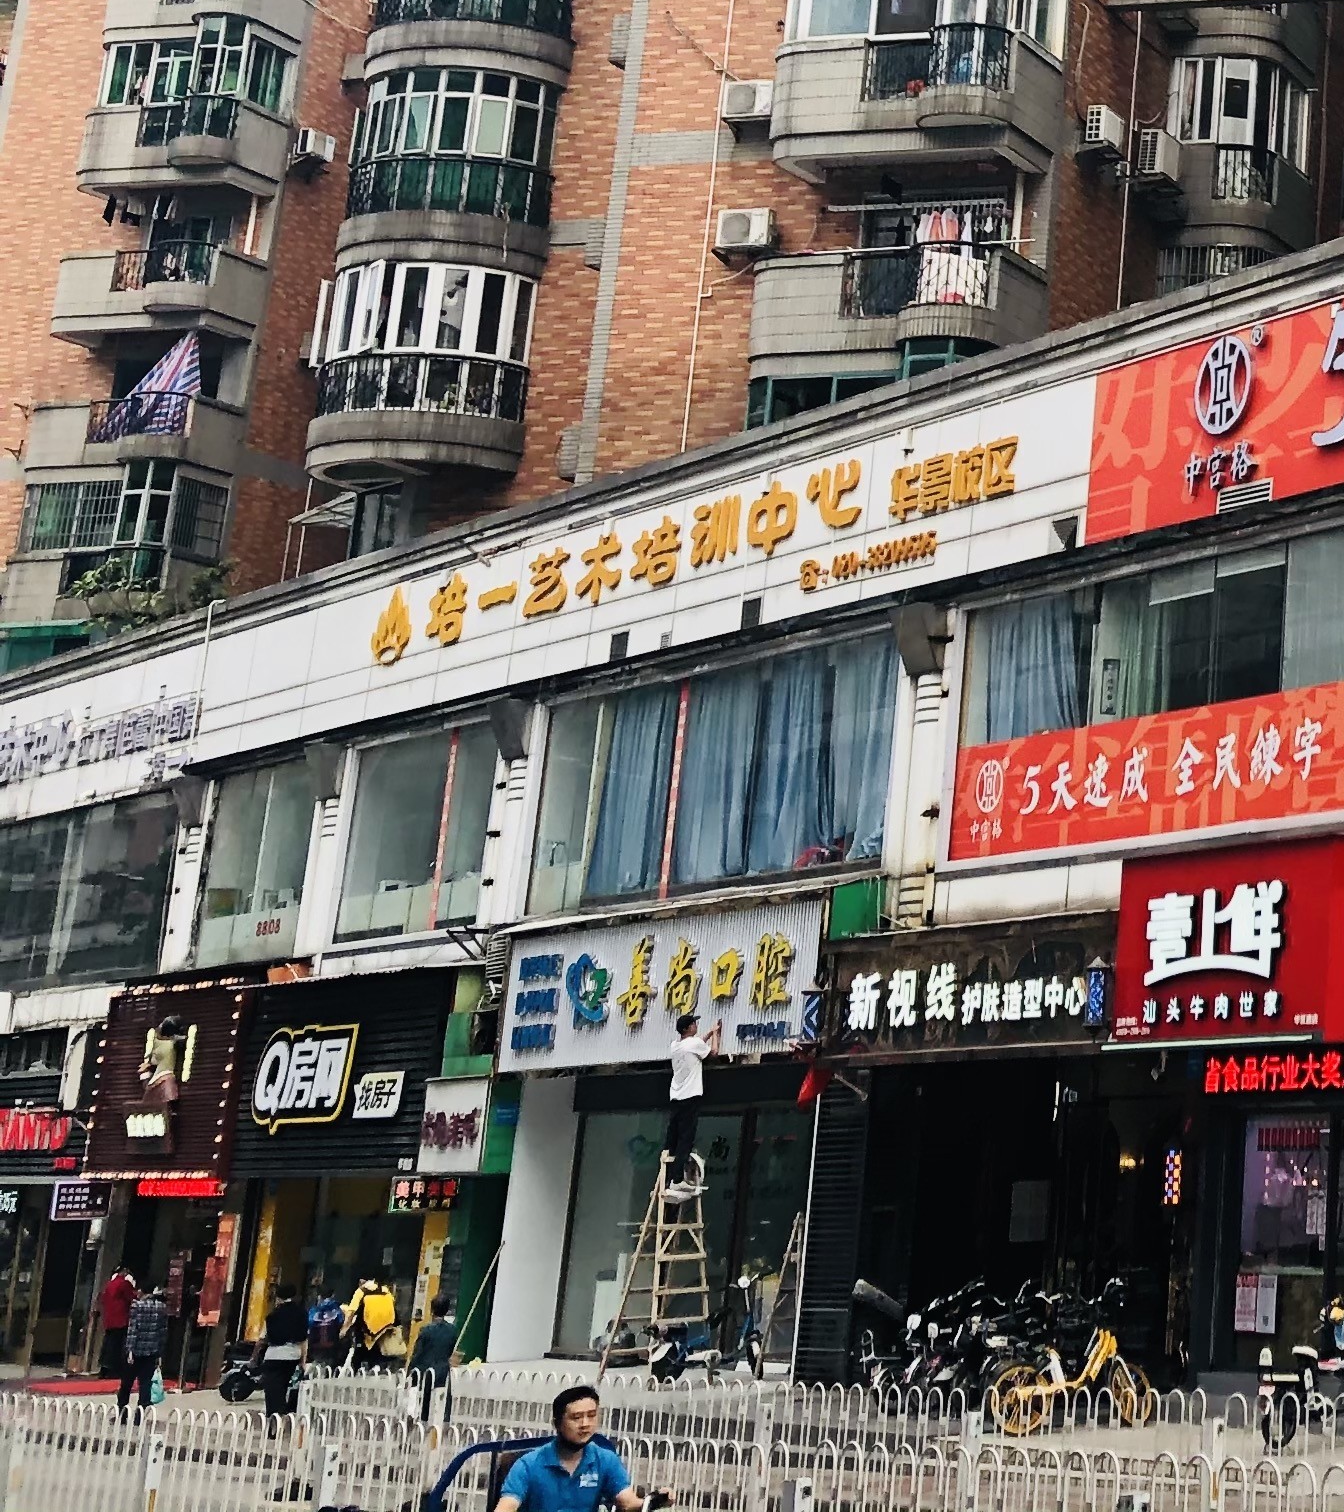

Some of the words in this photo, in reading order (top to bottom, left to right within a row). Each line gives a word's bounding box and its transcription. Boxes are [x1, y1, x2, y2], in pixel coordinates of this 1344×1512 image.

[889, 436, 1019, 522] 华景校区
[1019, 745, 1150, 816] 5天速成
[1172, 717, 1322, 797] 全民練字
[256, 918, 281, 937] 8808
[848, 961, 957, 1032] 新视线
[961, 975, 1086, 1026] 护肤造型中心
[1143, 989, 1279, 1025] 汕头牛肉世家
[254, 1037, 350, 1116] Q房网
[357, 1078, 398, 1112] 找房子
